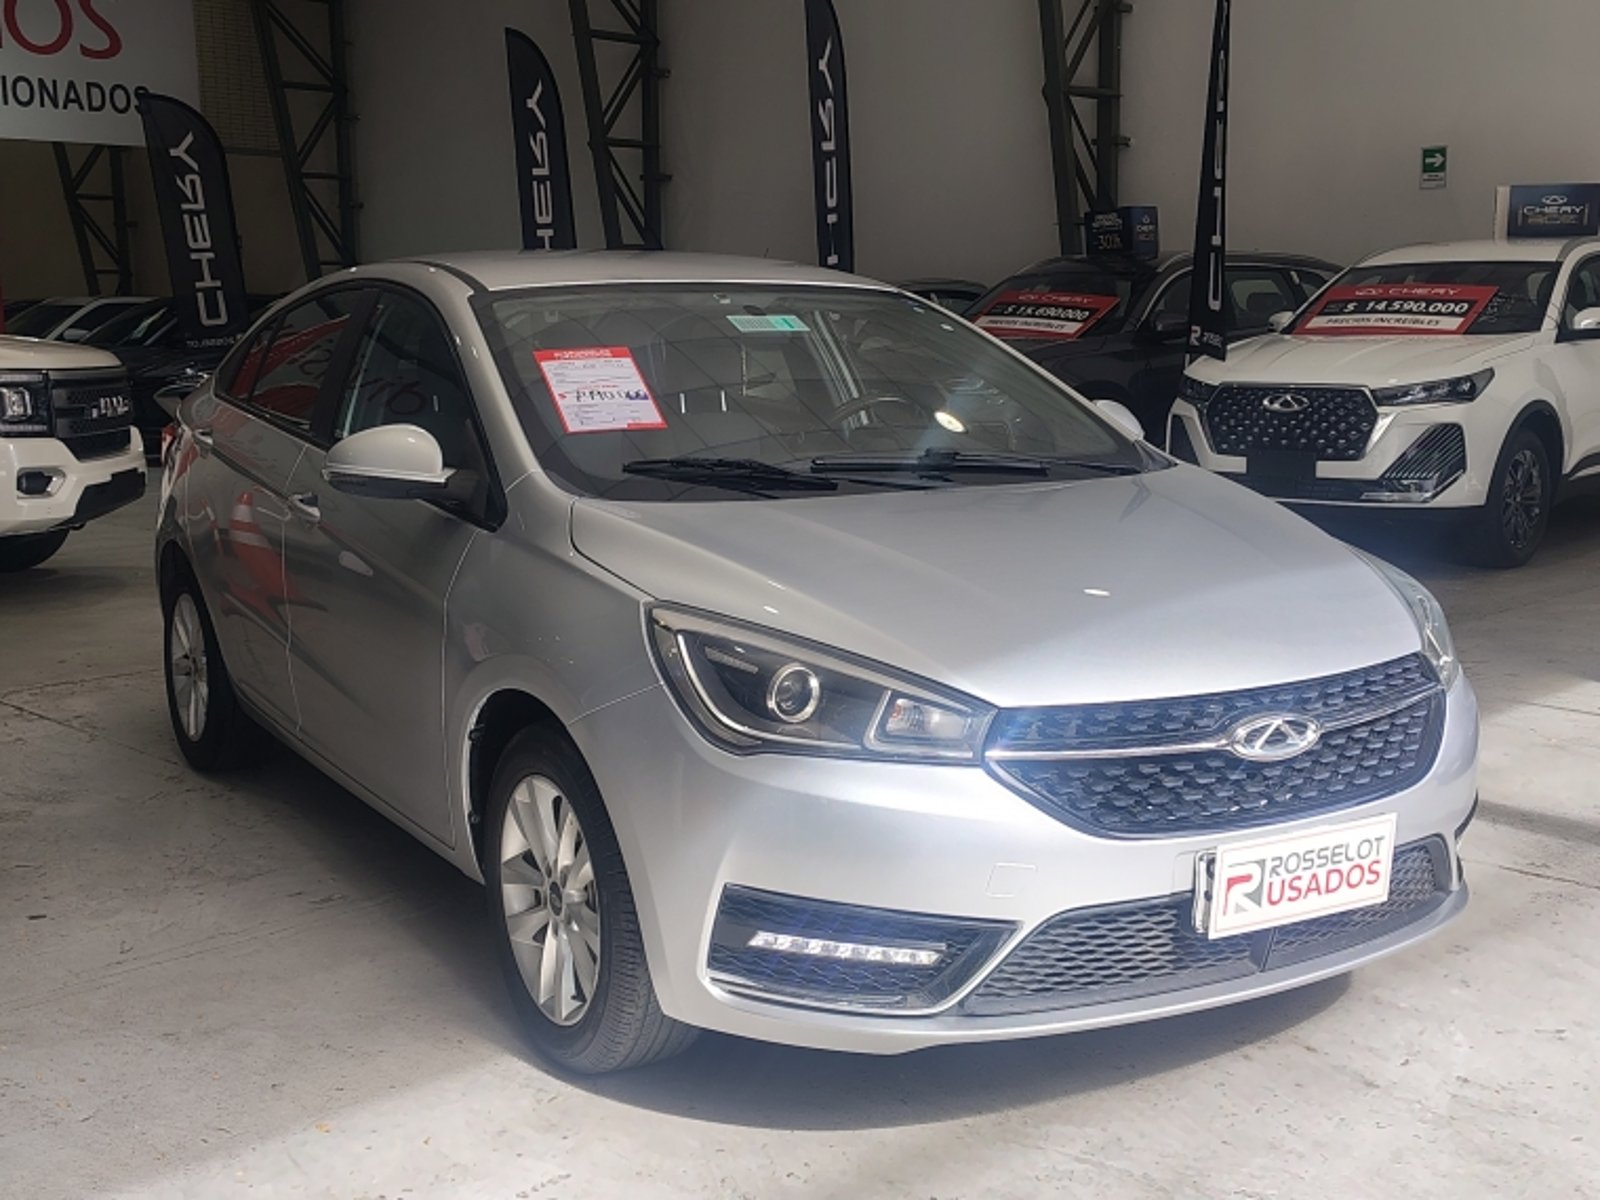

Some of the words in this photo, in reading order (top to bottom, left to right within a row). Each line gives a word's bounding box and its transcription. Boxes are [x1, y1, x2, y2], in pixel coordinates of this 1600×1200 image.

[1523, 205, 1584, 215] CHERY
[1389, 287, 1461, 296] CHERY
[1269, 836, 1385, 878] ROSSELOT
[1266, 860, 1382, 906] USADOS
